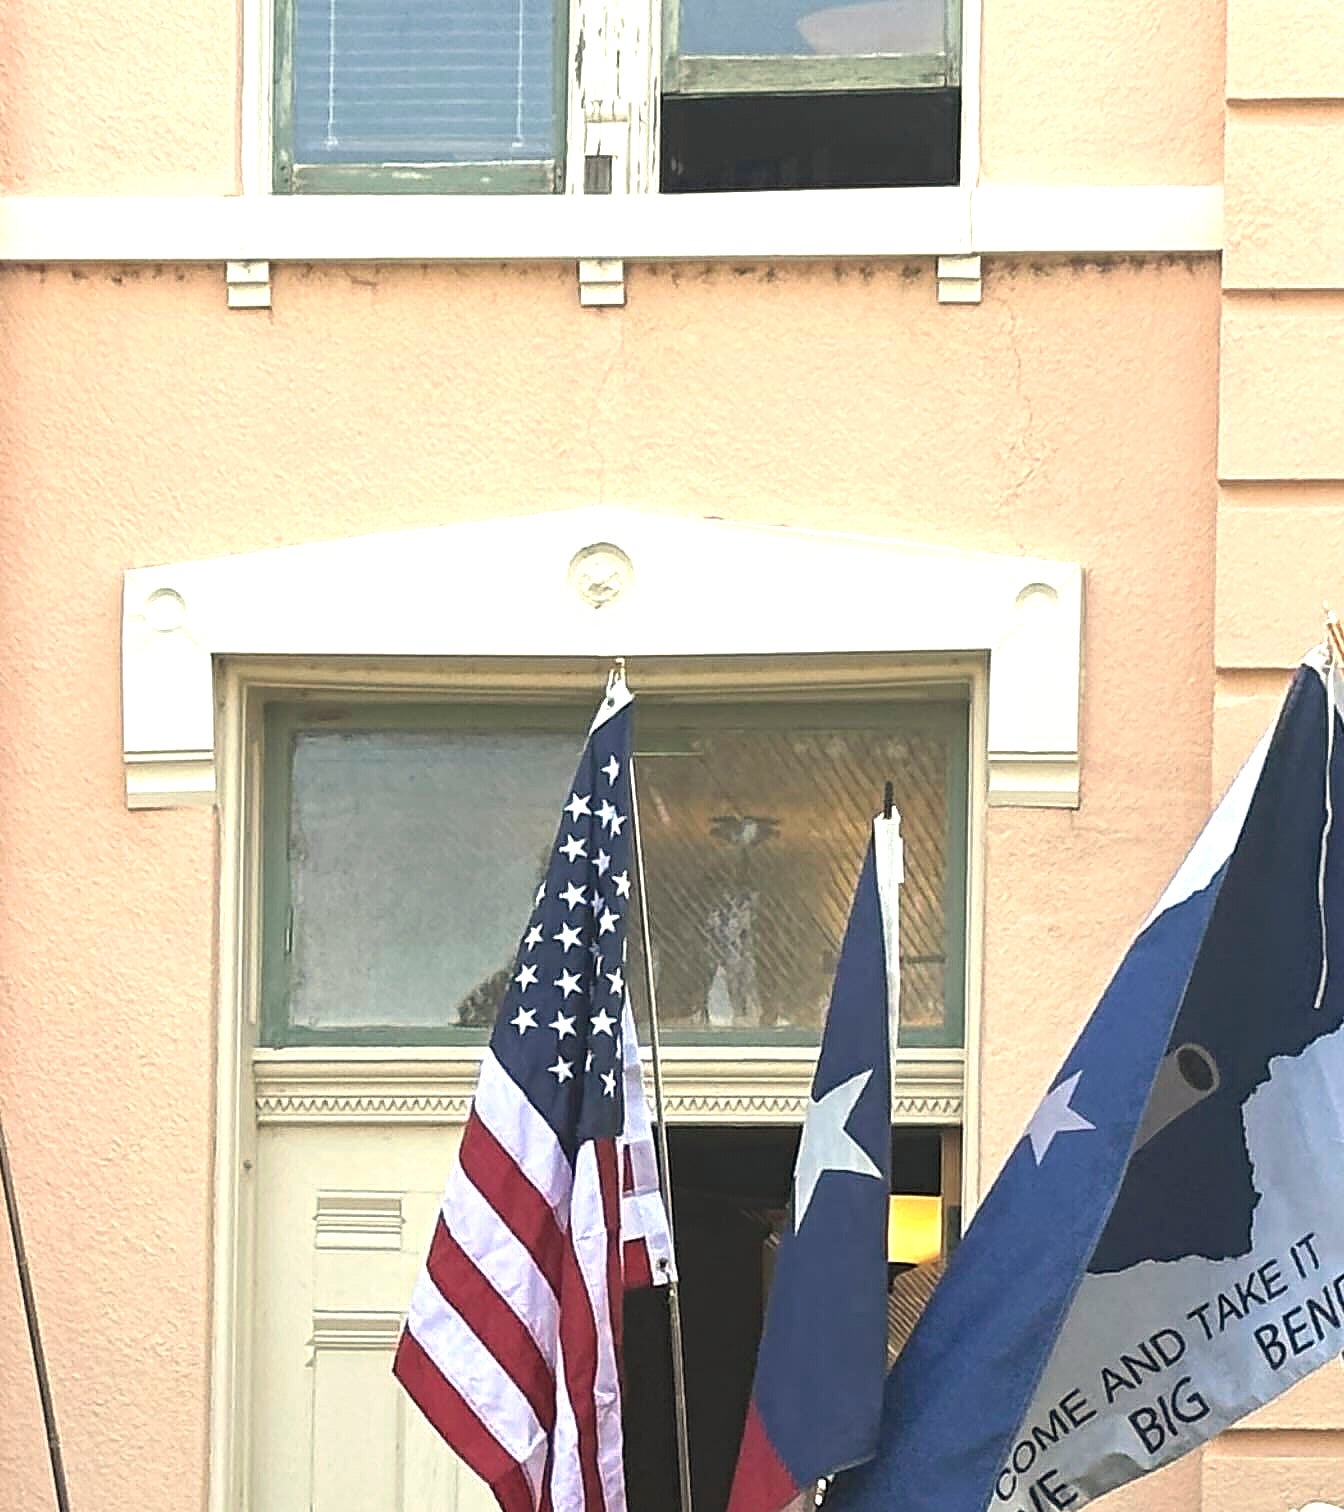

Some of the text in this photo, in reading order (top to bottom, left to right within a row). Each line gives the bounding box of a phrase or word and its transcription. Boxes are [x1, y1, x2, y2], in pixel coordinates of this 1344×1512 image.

[996, 1233, 1323, 1502] COME AND TAKE IT
[1128, 1376, 1210, 1454] BIG
